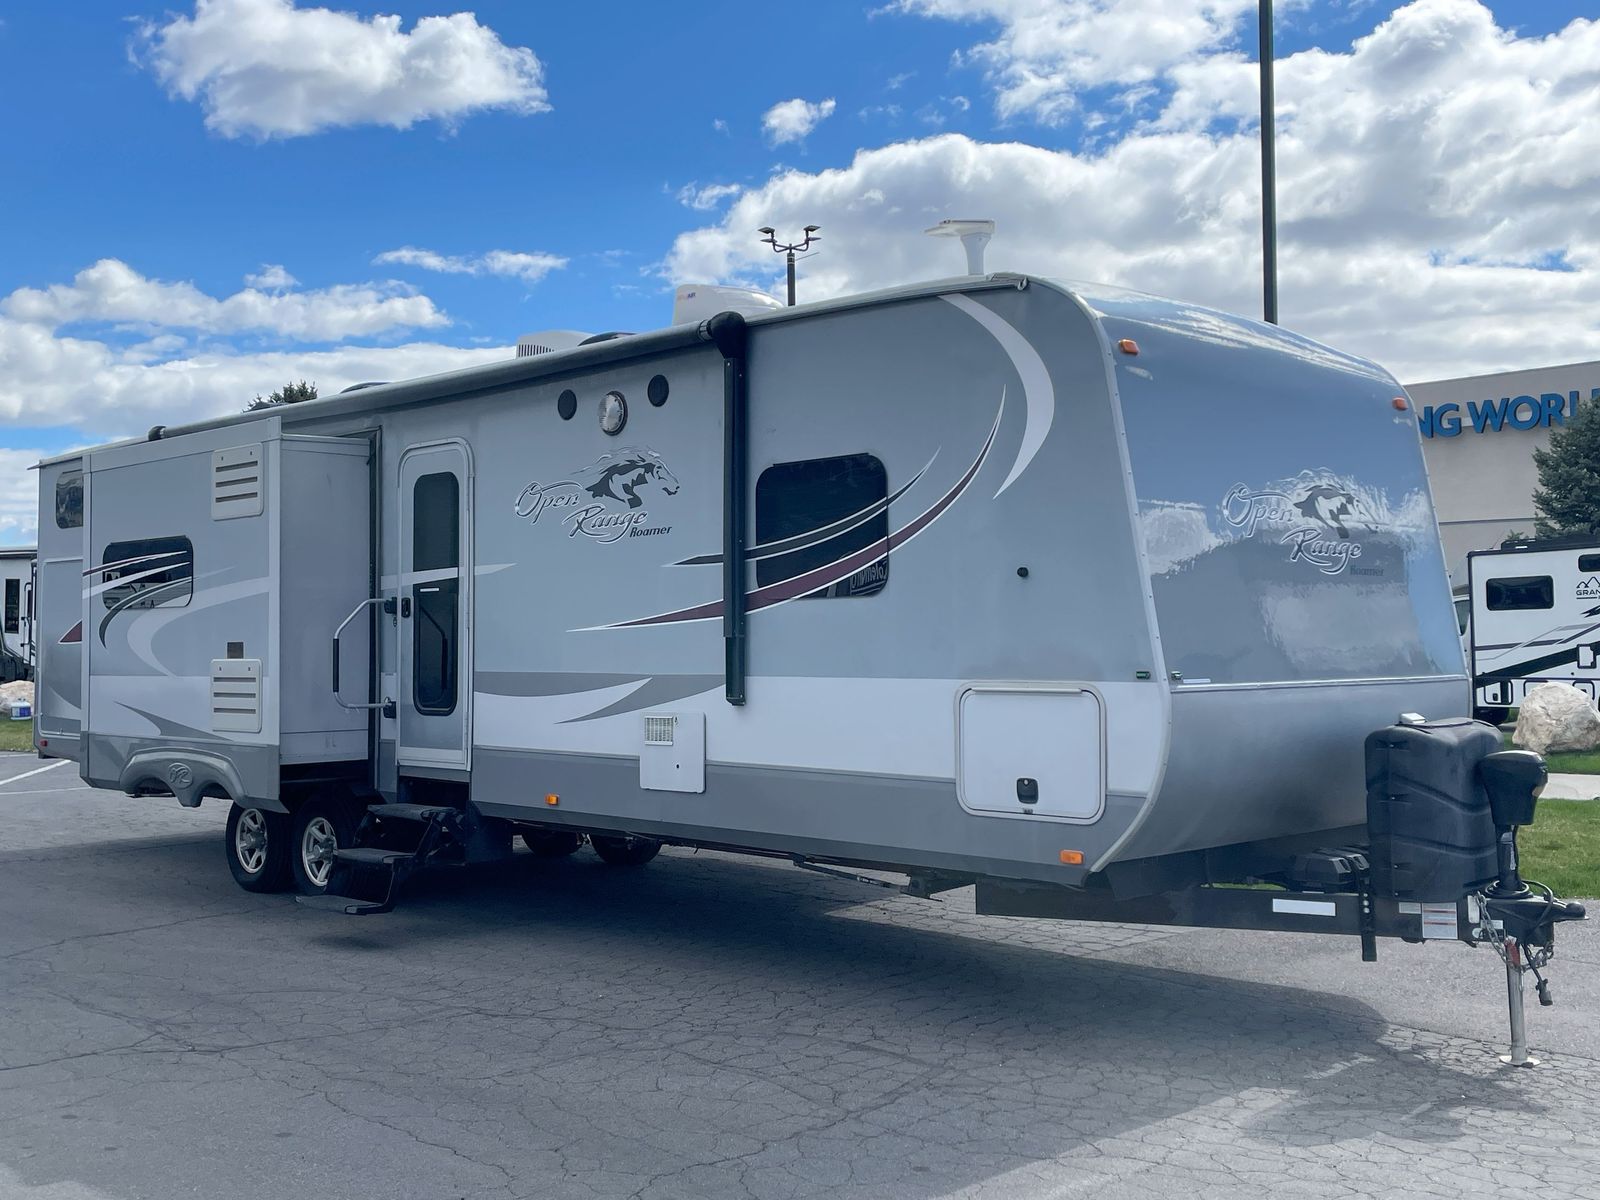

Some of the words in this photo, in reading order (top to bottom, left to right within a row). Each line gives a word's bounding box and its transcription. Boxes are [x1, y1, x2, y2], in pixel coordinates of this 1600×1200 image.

[515, 481, 583, 525] Open
[562, 502, 648, 544] Range
[1222, 482, 1296, 538] Open
[629, 526, 672, 538] Roamer
[1281, 526, 1362, 575] Range
